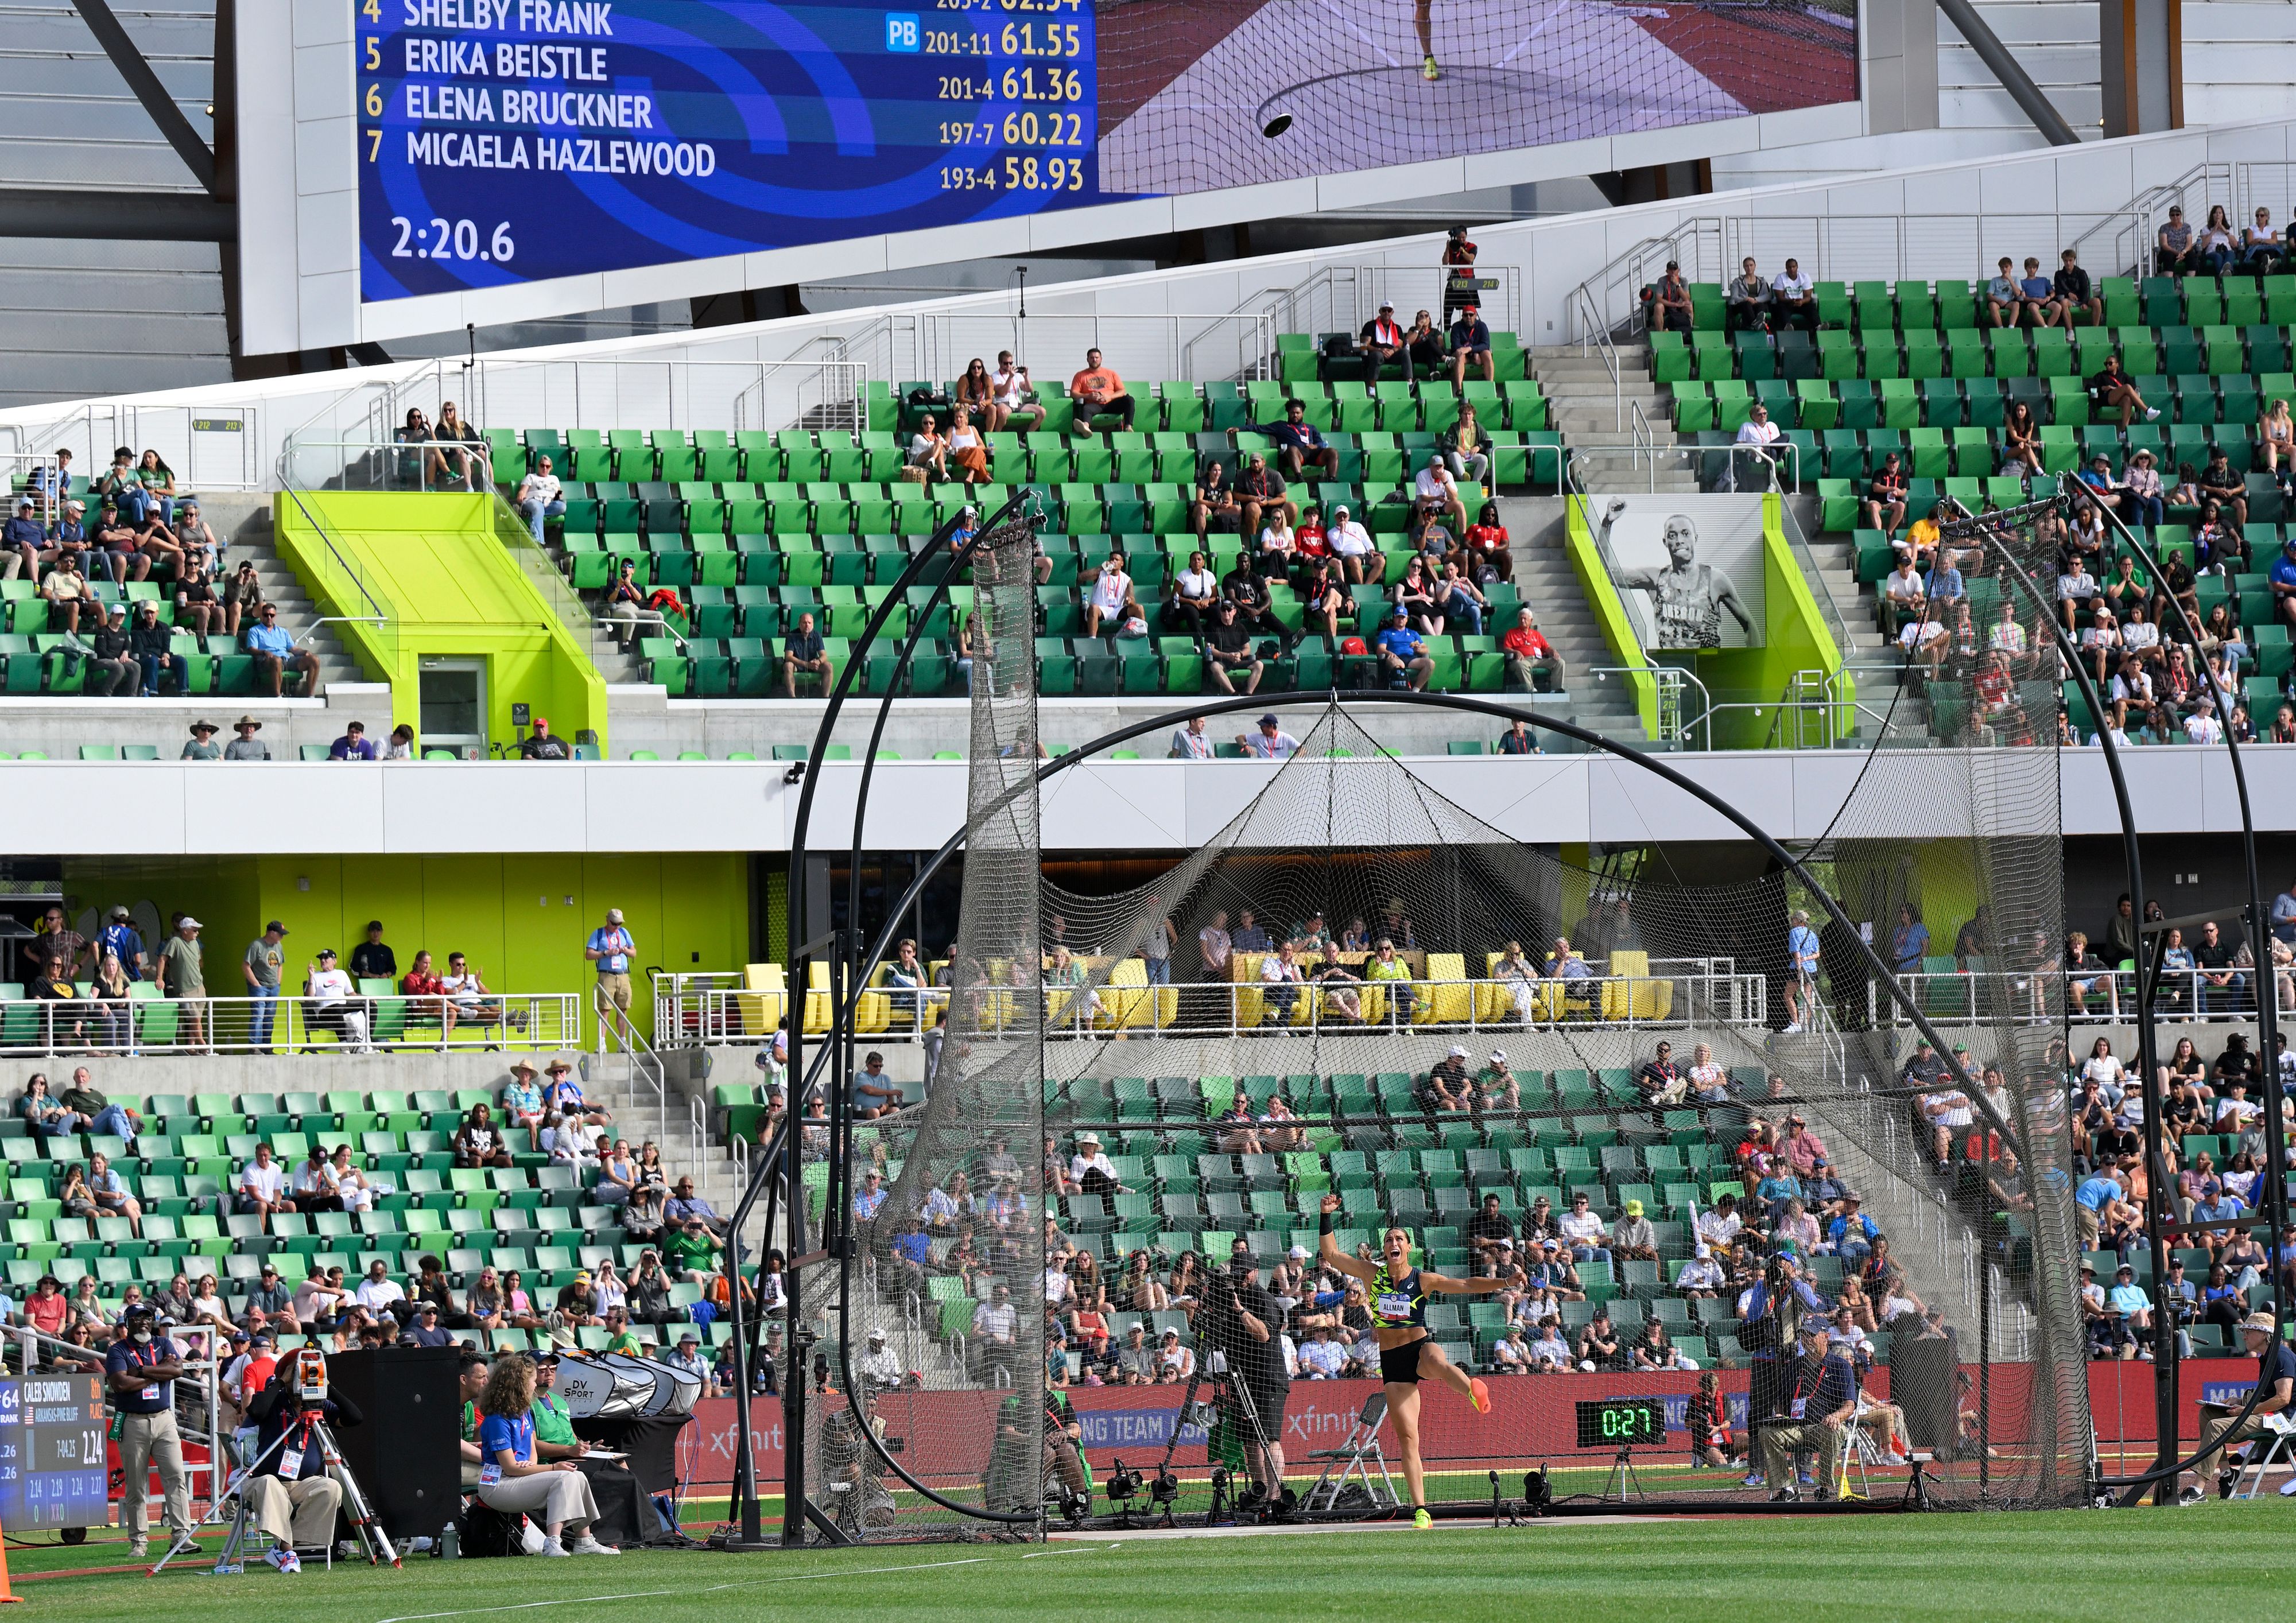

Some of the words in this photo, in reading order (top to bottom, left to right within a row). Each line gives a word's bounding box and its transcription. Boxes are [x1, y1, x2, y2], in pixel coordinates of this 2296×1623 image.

[363, 0, 381, 24] 4
[404, 0, 509, 30] SHELBY
[519, 0, 613, 36] FRANK
[889, 21, 917, 46] PB
[925, 31, 992, 55] 201-11
[1002, 22, 1080, 57] 61.55
[366, 37, 381, 70] 5
[405, 39, 488, 75] ERIKA
[497, 43, 607, 81] BEISTLE
[938, 76, 994, 100] 201-4
[1003, 67, 1082, 102] 61.36
[365, 84, 383, 117] 6
[407, 85, 494, 122] ELENA
[504, 90, 653, 129] BRUCKNER
[939, 122, 994, 145] 197-7
[1003, 111, 1082, 145] 60.22
[367, 130, 383, 162] 7
[408, 132, 529, 170] MICAELA
[537, 138, 716, 177] HAZLEWOOD
[941, 167, 996, 190] 193-4
[1005, 157, 1083, 191] 58.93
[391, 216, 514, 262] 2:20.6
[199, 421, 210, 430] 212
[226, 421, 237, 430] 213
[1662, 604, 1704, 622] OREGON
[1663, 701, 1676, 709] 213
[24, 1381, 42, 1402] CALEB
[42, 1381, 71, 1402] SNOWDEN
[91, 1377, 101, 1399] 8th
[573, 1380, 587, 1389] DV
[0, 1389, 20, 1408] 64
[90, 1403, 103, 1419] PLACE
[0, 1414, 18, 1423] RANK
[67, 1407, 78, 1422] BLUFF
[1603, 1408, 1649, 1436] 0:27
[710, 1423, 785, 1459] xfnit
[1113, 1416, 1162, 1440] TEAM
[83, 1430, 103, 1464] 2.24
[30, 1479, 42, 1498] 2.14
[72, 1477, 83, 1496] 2.24
